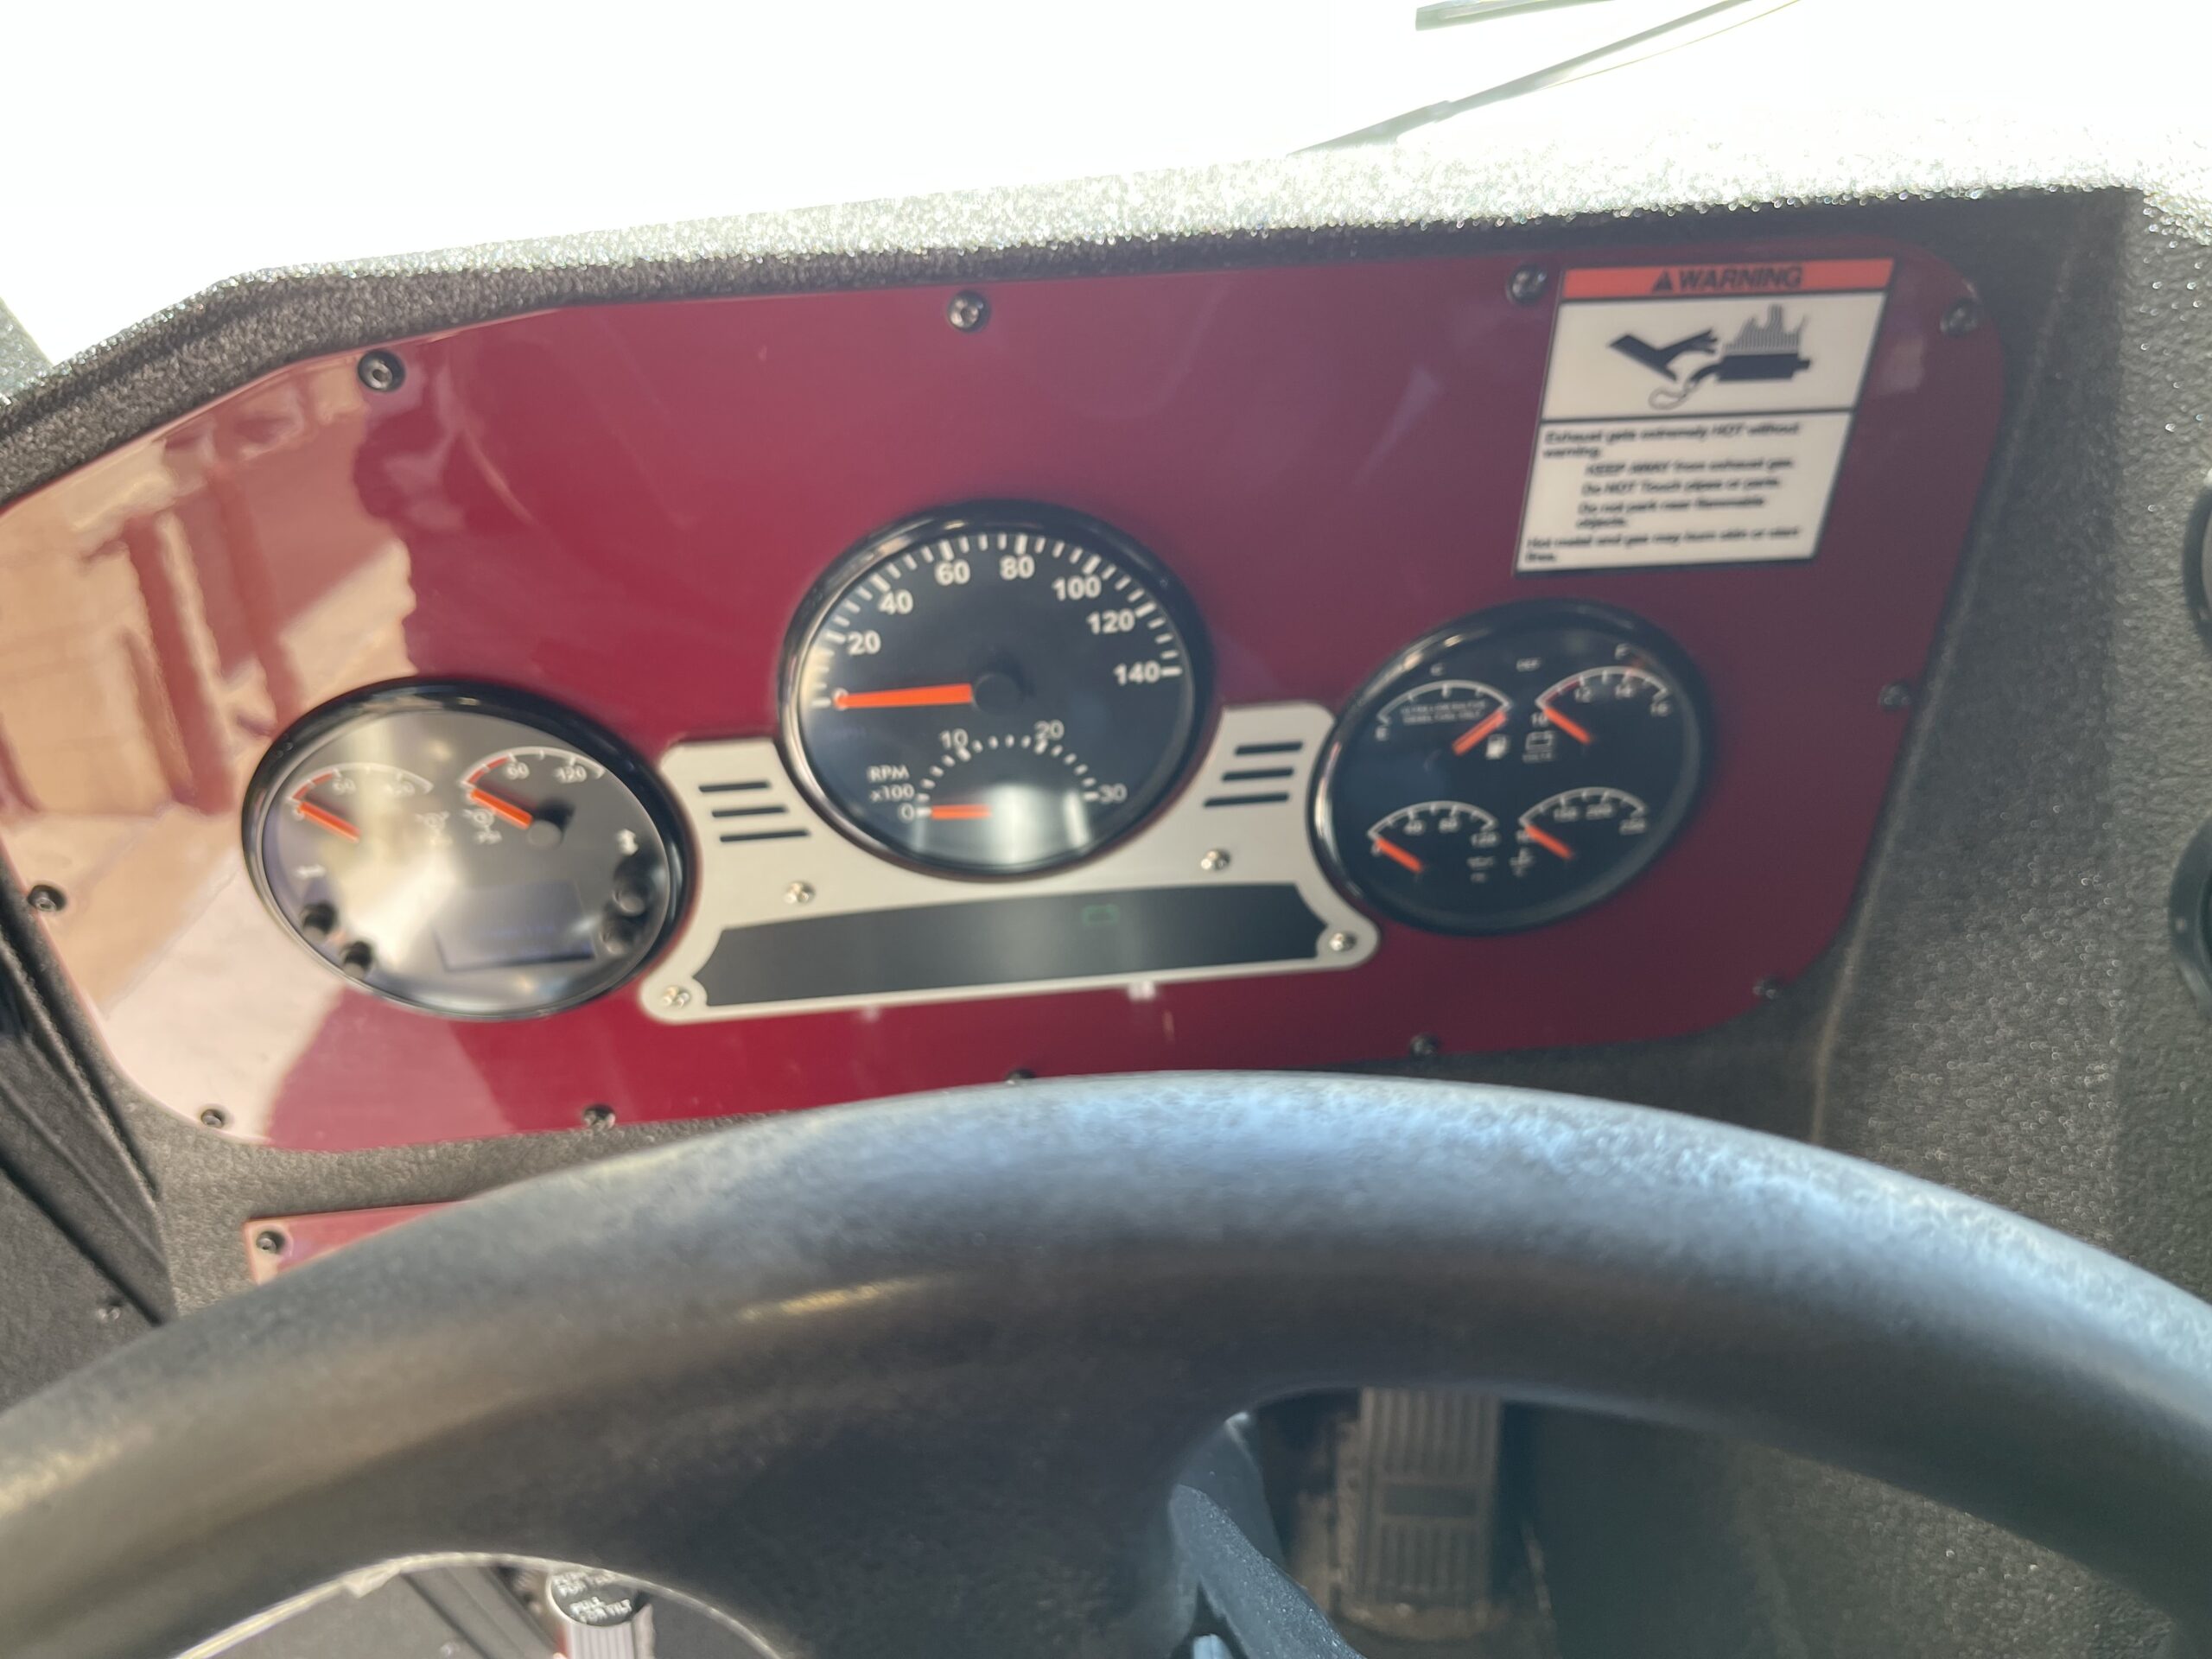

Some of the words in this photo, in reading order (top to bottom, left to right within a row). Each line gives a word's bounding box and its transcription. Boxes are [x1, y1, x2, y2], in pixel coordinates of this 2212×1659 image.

[1679, 268, 1802, 289] WARNING
[1713, 424, 1742, 435] HOT
[1605, 481, 1637, 494] NOT
[935, 560, 971, 585] 60
[1000, 556, 1035, 579] 80
[1053, 576, 1102, 601] 100
[879, 591, 913, 614] 40
[1086, 609, 1135, 635] 120
[847, 631, 881, 655] 20
[1114, 662, 1160, 685] 140
[940, 729, 969, 752] 10
[1035, 720, 1065, 741] 20
[505, 762, 530, 779] 60
[555, 766, 588, 783] 120
[868, 766, 909, 782] RPM
[1098, 784, 1127, 804] 30
[900, 804, 914, 821] 0
